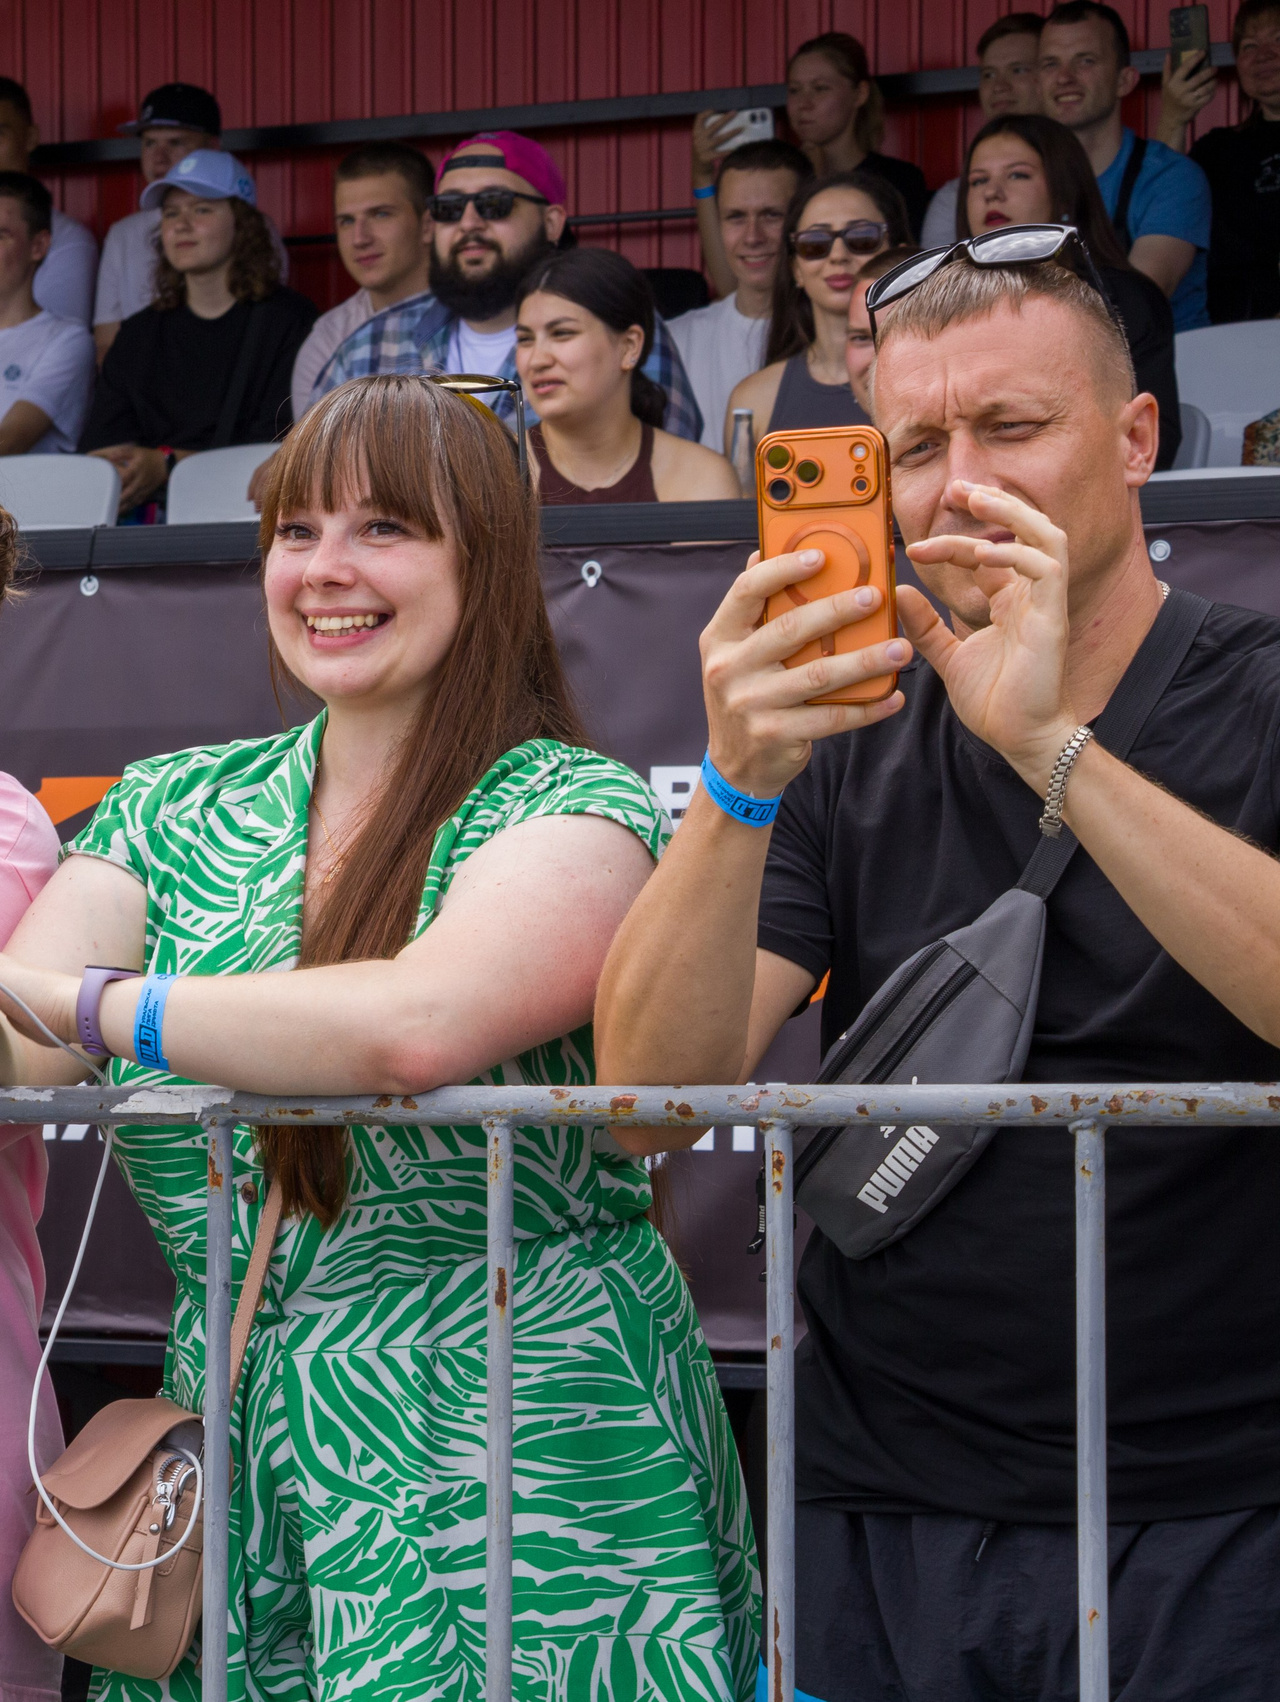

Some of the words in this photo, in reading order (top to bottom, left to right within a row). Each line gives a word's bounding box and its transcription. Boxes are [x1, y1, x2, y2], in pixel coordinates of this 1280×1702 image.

[731, 799, 774, 821] ULD
[140, 1025, 159, 1063] ULD
[856, 1126, 940, 1214] PUMA
[758, 1204, 766, 1233] PUMA
